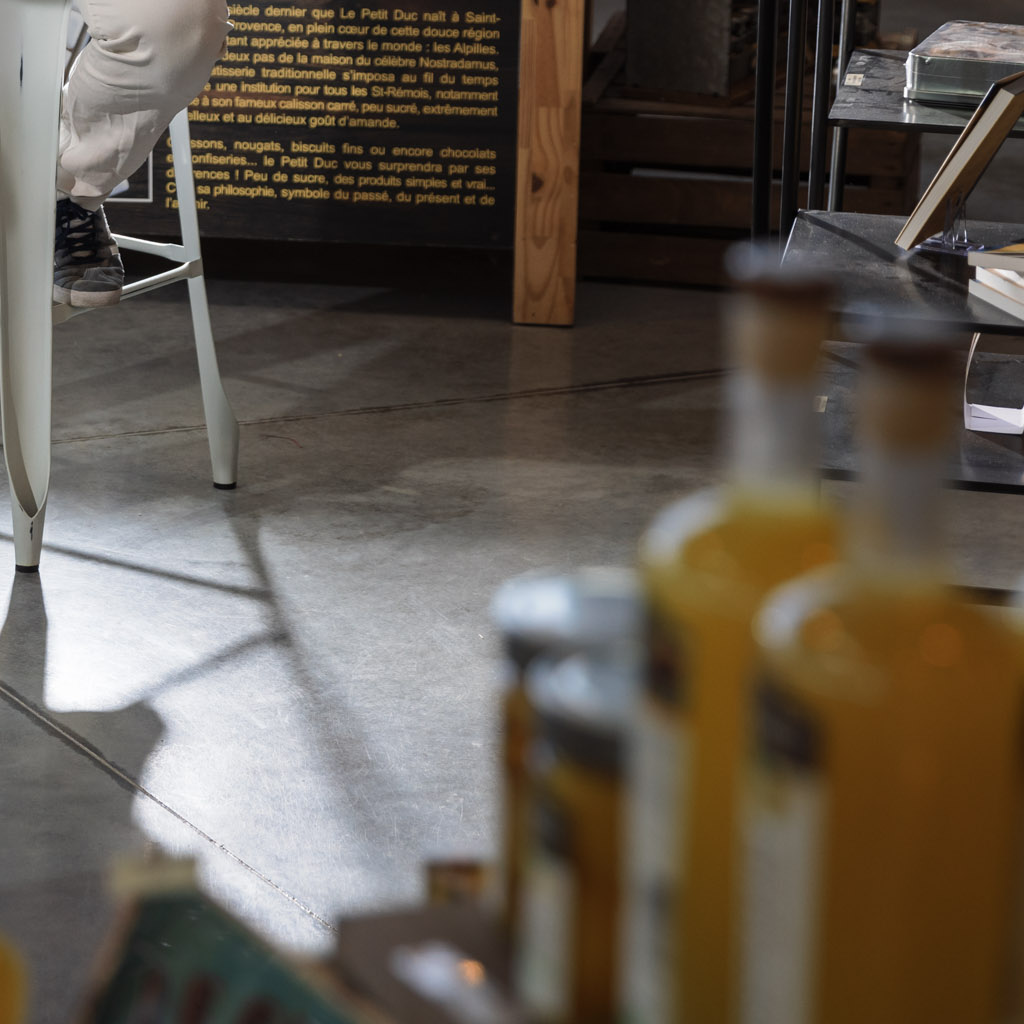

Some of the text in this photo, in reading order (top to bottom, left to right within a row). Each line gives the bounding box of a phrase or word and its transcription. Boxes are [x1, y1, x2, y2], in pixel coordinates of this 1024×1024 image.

[228, 3, 502, 25] siècle dernier que Le Petit Duc naît à Saint-
[288, 23, 304, 33] en
[306, 22, 335, 36] plein
[338, 25, 370, 35] cœur
[372, 24, 388, 36] de
[390, 25, 420, 37] cette
[422, 26, 460, 38] douce
[462, 27, 501, 41] région
[250, 36, 309, 49] appréciée
[312, 37, 320, 49] à
[323, 38, 364, 50] travers
[367, 39, 379, 51] le
[381, 40, 423, 52] monde
[433, 41, 452, 54] les
[453, 42, 499, 55] Alpilles.
[253, 53, 276, 64] pas
[278, 51, 294, 64] de
[297, 52, 309, 64] la
[311, 53, 354, 66] maison
[356, 55, 371, 67] du
[374, 55, 417, 68] célèbre
[419, 56, 500, 71] Nostradamus,
[212, 64, 256, 78] tisserie
[261, 66, 337, 81] traditionnelle
[401, 74, 418, 84] au
[422, 72, 434, 84] fil
[439, 73, 456, 85] du
[461, 74, 500, 88] temps
[215, 82, 237, 93] une
[240, 81, 292, 94] institution
[295, 85, 321, 97] pour
[323, 85, 348, 97] tous
[350, 85, 368, 97] les
[371, 85, 433, 100] St-Rémois,
[435, 88, 499, 101] notamment
[200, 95, 210, 107] à
[211, 97, 233, 107] son
[234, 96, 277, 109] fameux
[278, 97, 325, 111] calisson
[326, 100, 359, 113] carré,
[361, 103, 384, 115] peu
[386, 102, 421, 115] sucré,
[422, 103, 498, 117] extrêmement
[187, 111, 400, 129] elleux et au délicieux goût d'amande.
[233, 139, 285, 154] nougats,
[291, 141, 336, 154] biscuits
[342, 143, 364, 155] fins
[370, 146, 386, 156] ou
[392, 147, 434, 157] encore
[439, 147, 497, 160] chocolats
[191, 153, 497, 176] onfiseries... le Petit Duc vous surprendra par ses
[244, 169, 269, 182] Peu
[272, 171, 289, 183] de
[292, 173, 330, 186] sucre,
[333, 173, 356, 185] des
[358, 175, 403, 188] produits
[405, 177, 449, 191] simples
[450, 179, 463, 190] et
[197, 184, 496, 206] sa philosophie, symbole du passé, du présent et de
